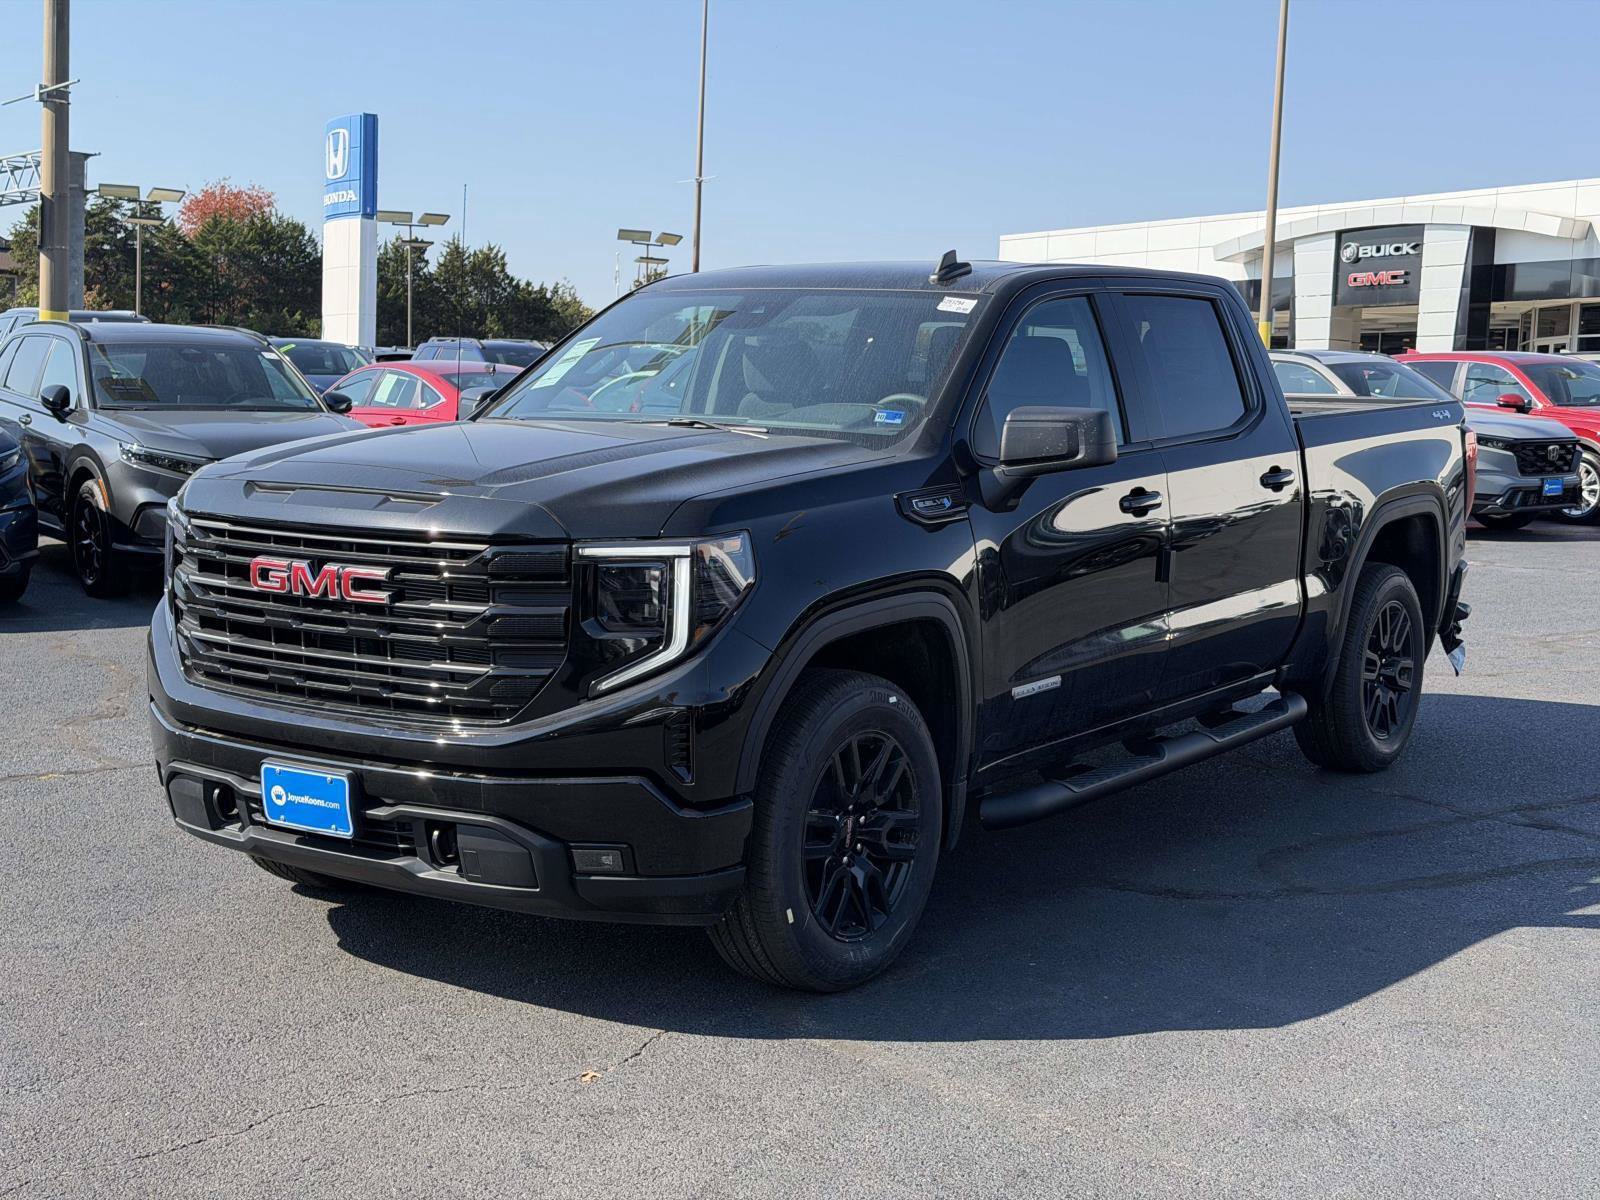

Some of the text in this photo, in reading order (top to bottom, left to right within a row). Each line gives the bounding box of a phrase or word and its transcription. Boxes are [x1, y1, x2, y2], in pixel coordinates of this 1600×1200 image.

[1358, 242, 1418, 258] BUICK
[1347, 270, 1405, 287] GMC
[250, 556, 392, 604] GMC
[287, 793, 341, 810] JoyceKoons.com
